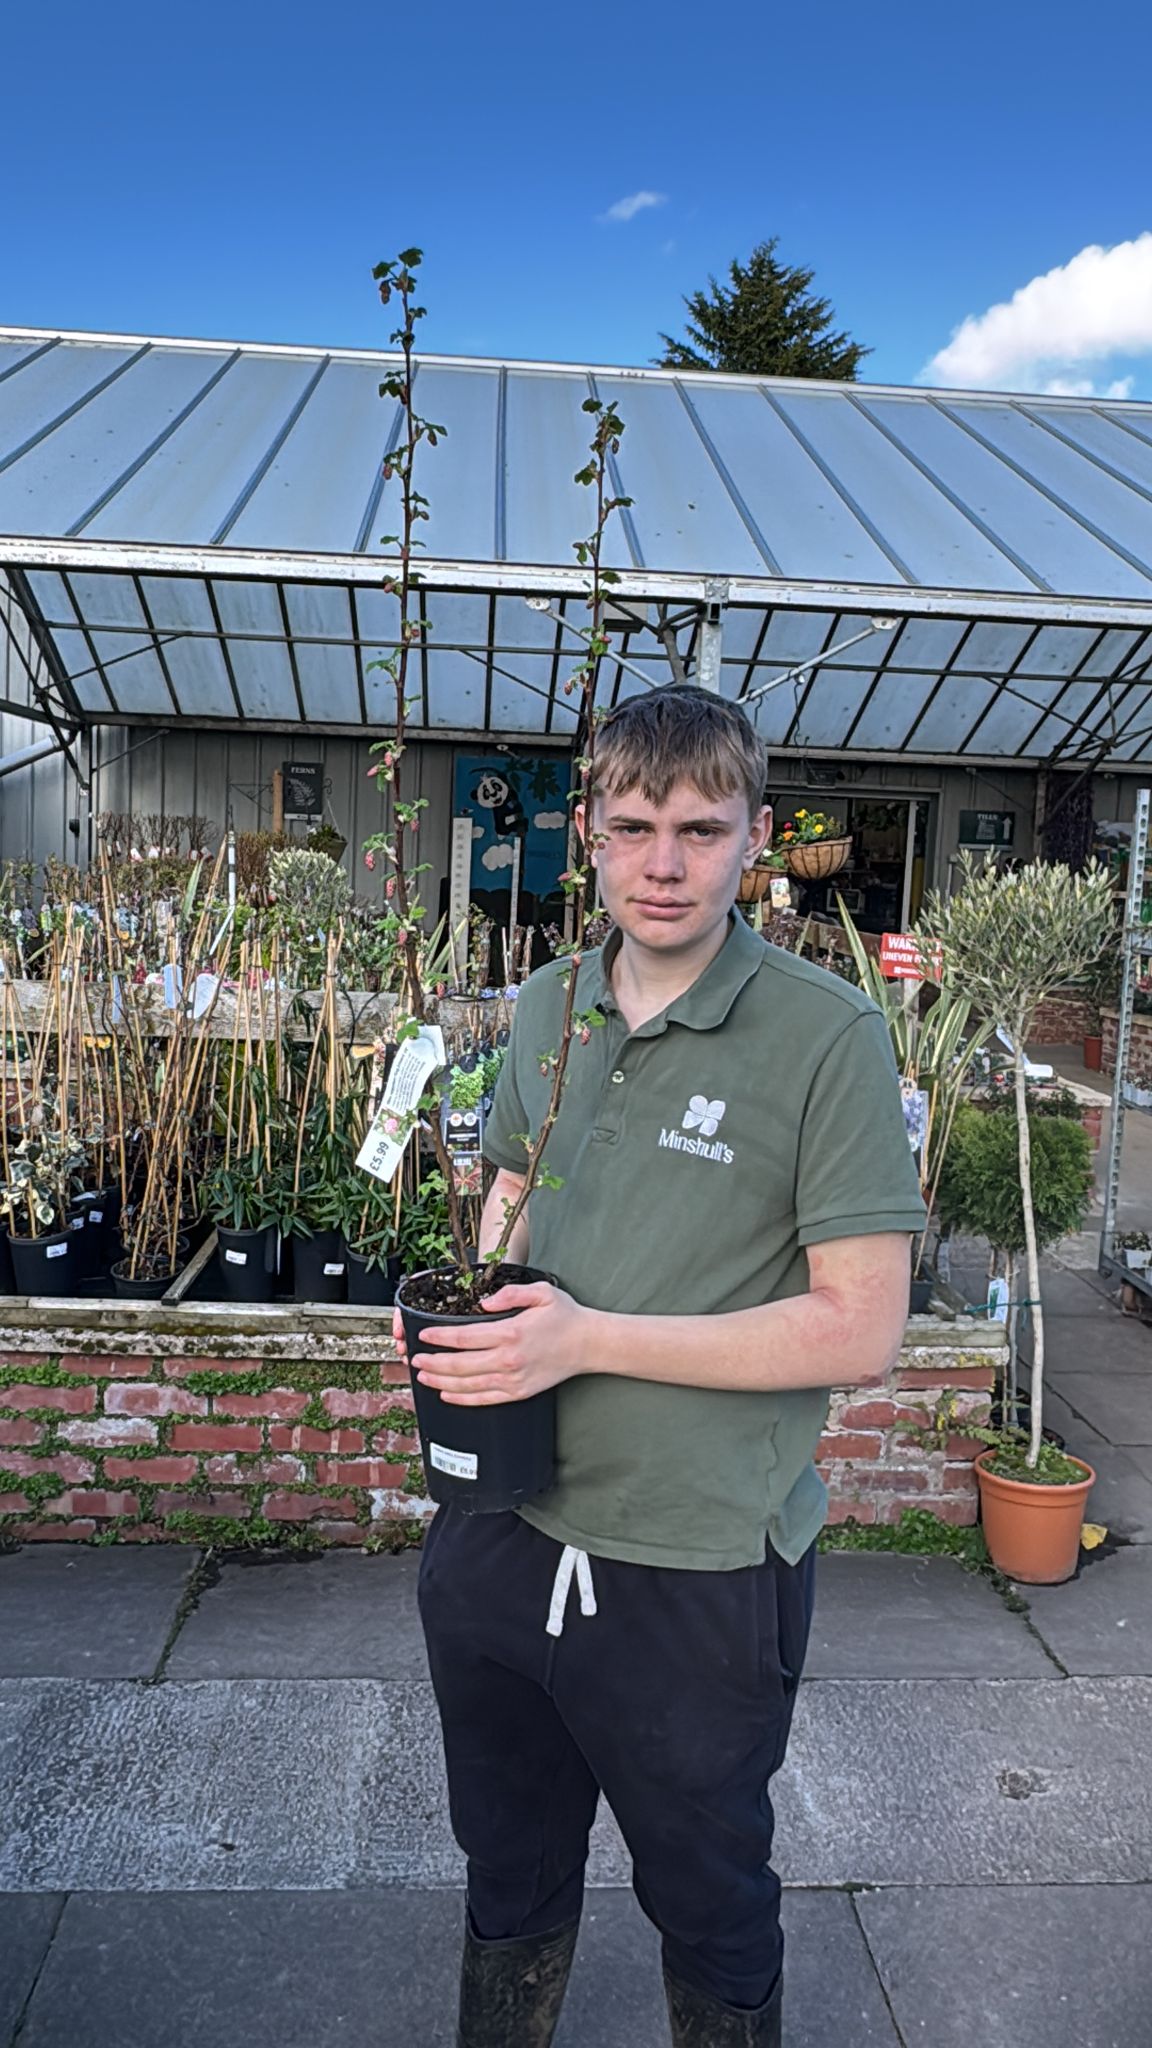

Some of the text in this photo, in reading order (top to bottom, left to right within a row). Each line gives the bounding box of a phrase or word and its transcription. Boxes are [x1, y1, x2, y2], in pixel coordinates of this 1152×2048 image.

[882, 951, 913, 963] UNEVEN
[369, 1141, 389, 1171] £5.99
[658, 1128, 734, 1164] Minshull's
